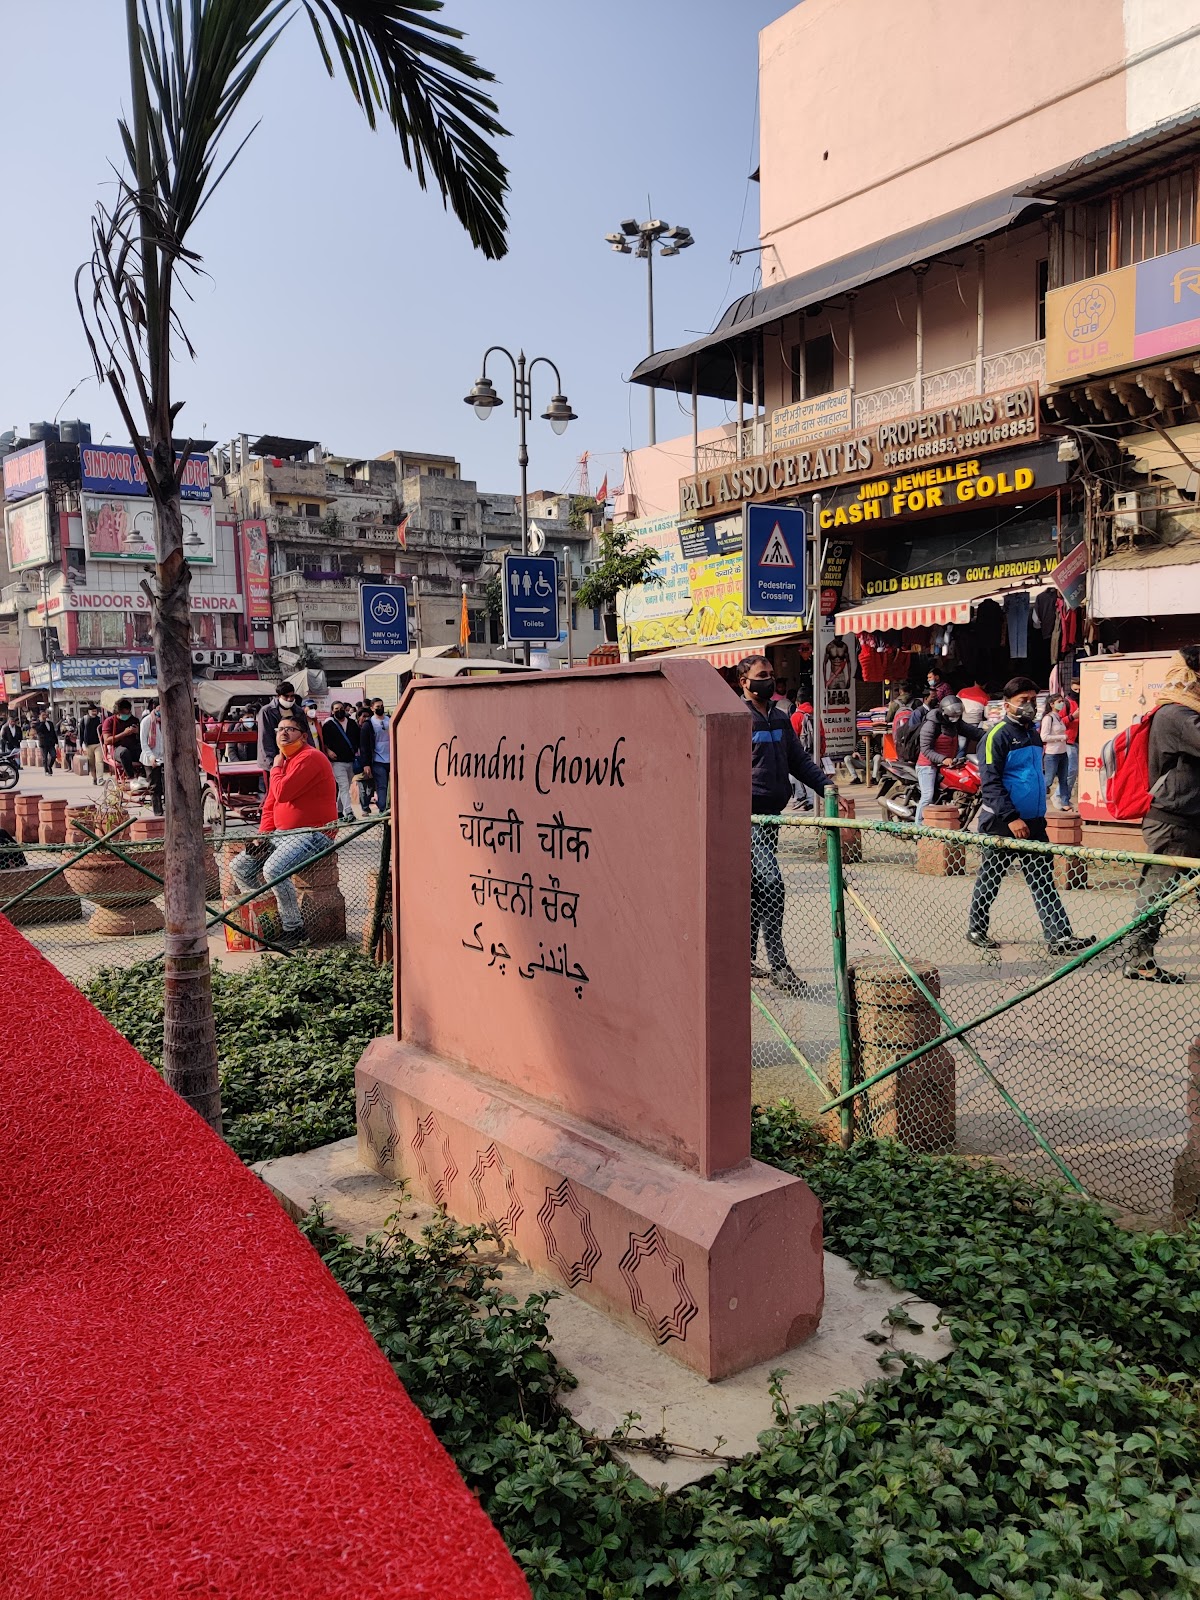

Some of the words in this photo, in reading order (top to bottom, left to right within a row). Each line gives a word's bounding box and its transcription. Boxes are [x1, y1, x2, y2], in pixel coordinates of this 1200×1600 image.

[1072, 323, 1098, 338] CUB
[1067, 340, 1110, 364] CUB
[774, 425, 788, 439] भाई
[788, 421, 800, 435] मती
[801, 417, 815, 431] दास
[816, 408, 848, 428] संग्रहालय
[83, 449, 133, 485] SINDOOR
[680, 477, 714, 514] PAL
[718, 435, 873, 503] ASSOCEEATES
[857, 481, 890, 501] JMD
[892, 459, 981, 494] JEWELLER
[819, 500, 882, 529] CASH
[892, 487, 943, 516] FOR
[956, 467, 1035, 502] GOLD
[654, 520, 673, 532] LASSI
[826, 557, 835, 565] WE
[824, 572, 842, 580] SILVER
[866, 578, 898, 595] GOLD
[901, 571, 943, 591] BUYER
[966, 567, 992, 582] GOVT.
[992, 559, 1041, 579] APPROVED
[1042, 557, 1059, 574] .VA
[758, 580, 796, 590] Pedestrian
[70, 594, 133, 608] SINDOOR
[760, 591, 794, 603] Crossing
[522, 620, 545, 628] Toilets
[386, 631, 400, 639] Only
[390, 638, 403, 646] 9pm
[62, 658, 132, 667] SINDOOR
[62, 667, 93, 677] SAREE
[94, 667, 119, 676] KEND
[433, 735, 526, 787] Chandni
[534, 736, 626, 795] Chowk
[1084, 756, 1103, 770] BS
[458, 801, 524, 854] चाँदनी
[536, 810, 593, 863] चौक
[469, 868, 534, 918] ਚਾਂਦਨੀ
[539, 873, 580, 928] ਚੌਕ
[518, 941, 590, 1000] چاندنی
